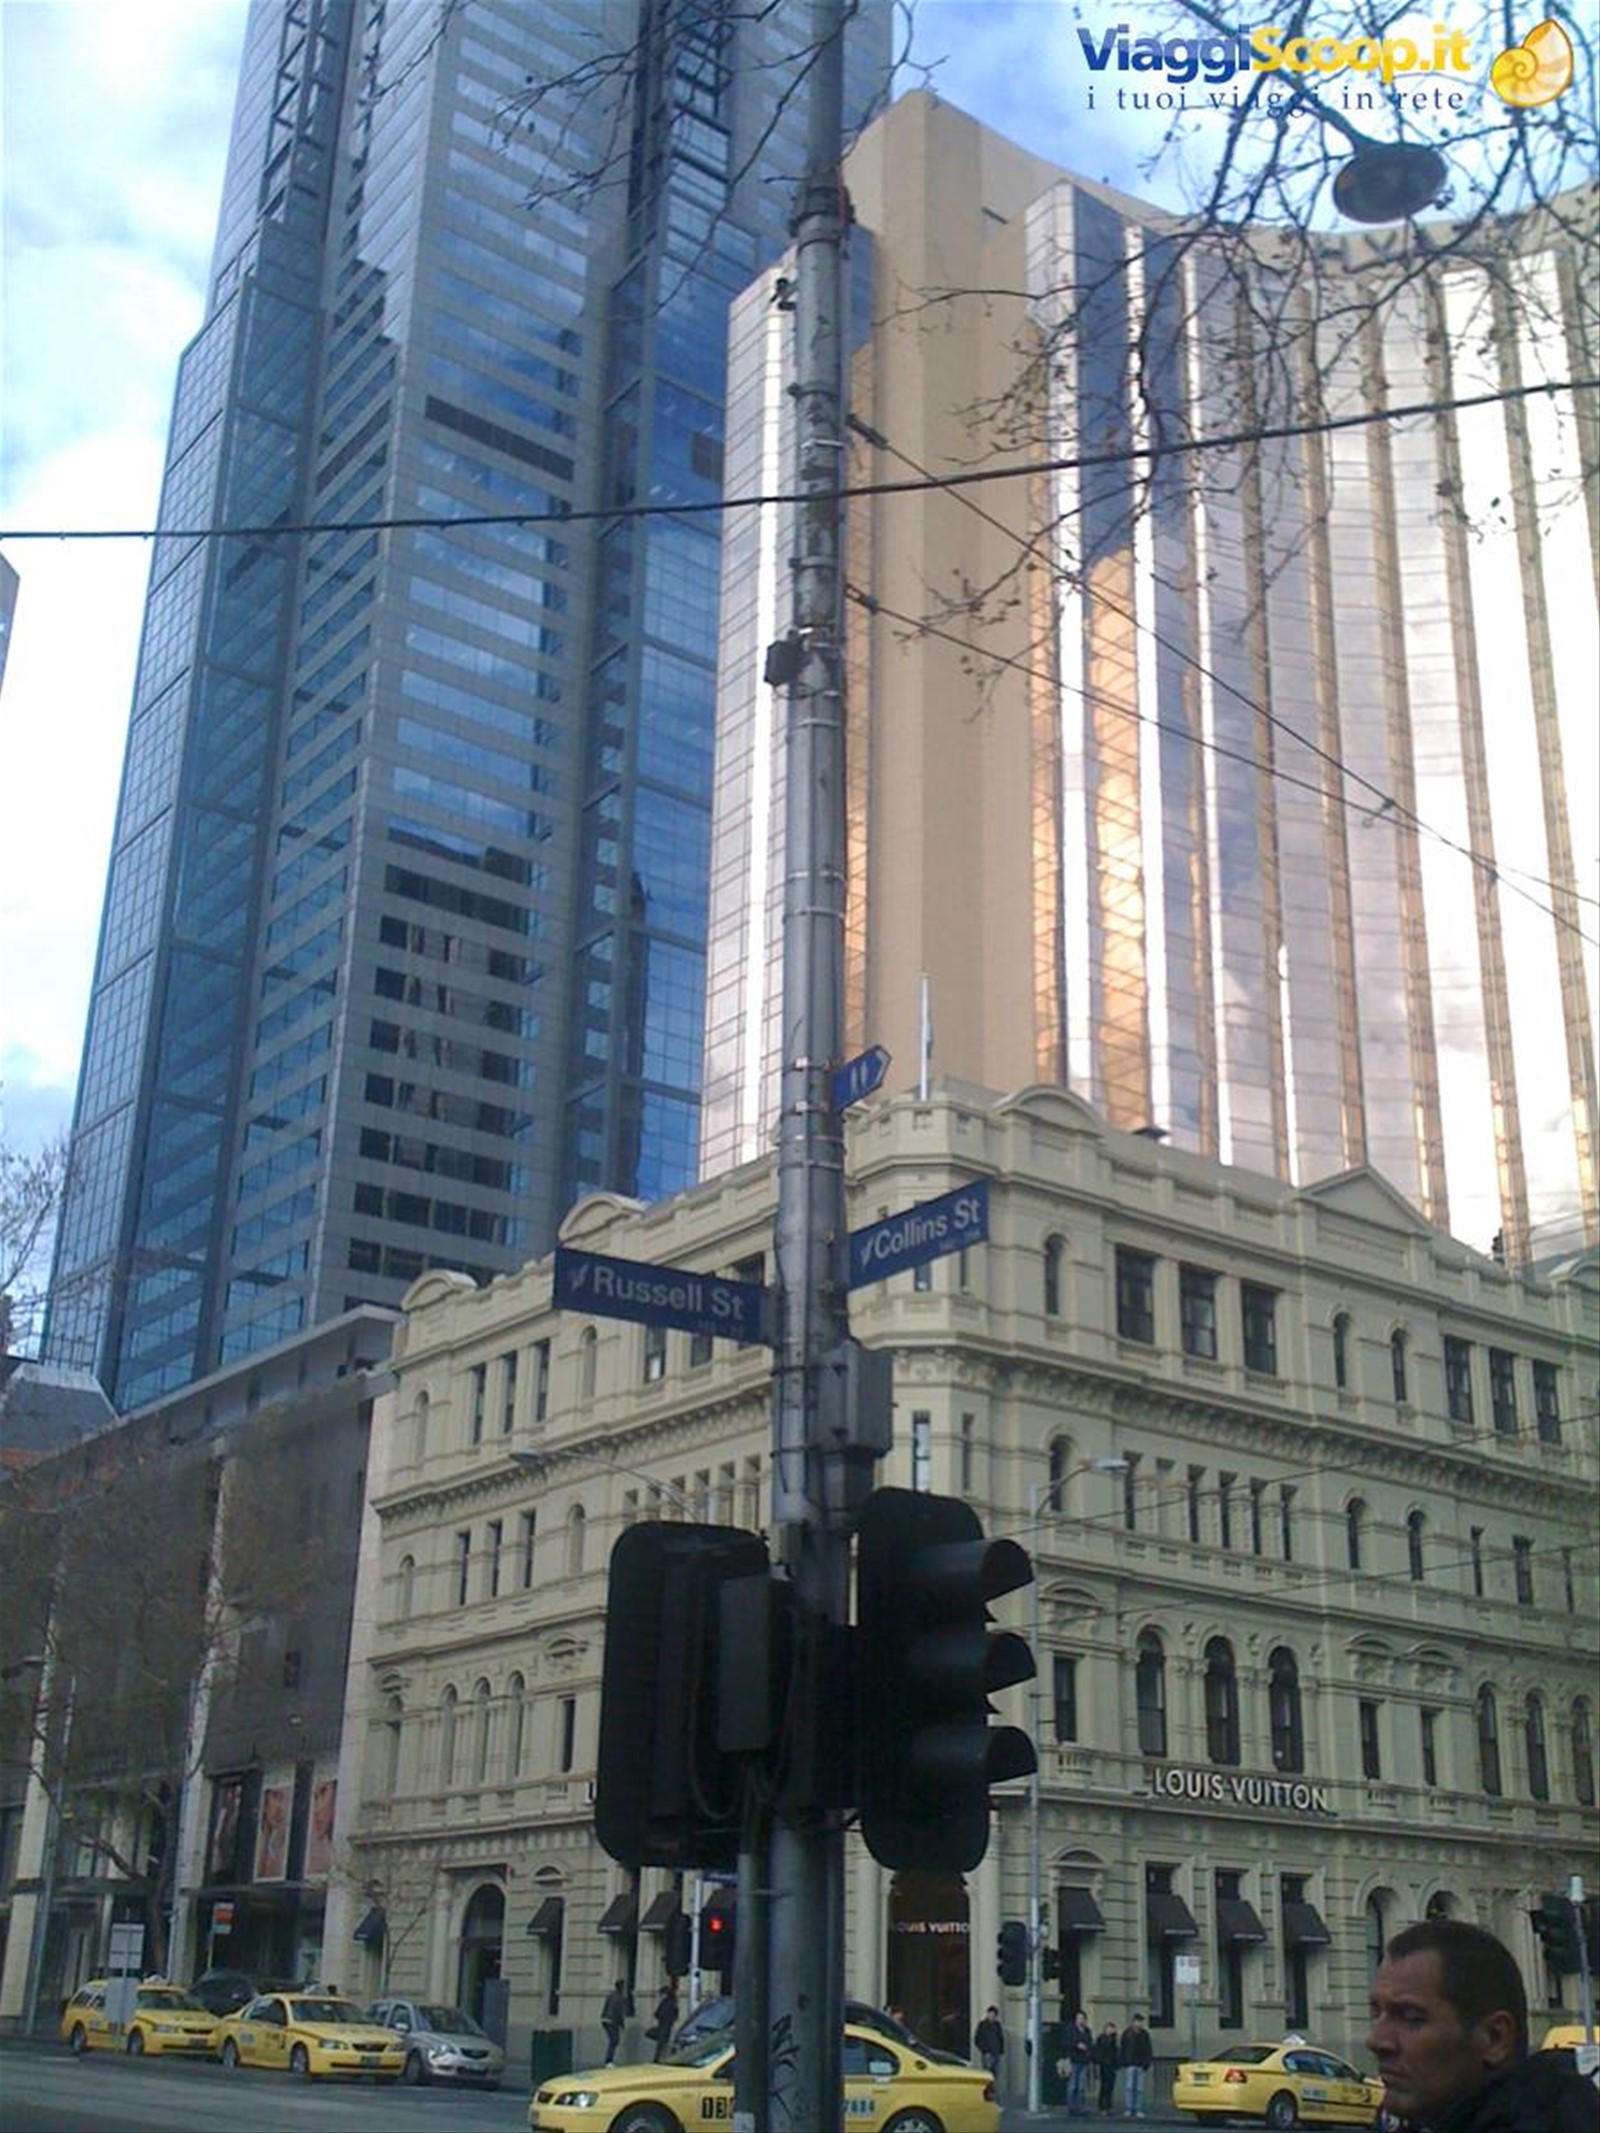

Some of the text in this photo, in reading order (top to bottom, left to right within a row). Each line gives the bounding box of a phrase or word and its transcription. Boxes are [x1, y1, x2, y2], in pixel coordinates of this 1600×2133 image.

[873, 1216, 948, 1261] Collins
[953, 1197, 981, 1231] St
[593, 1265, 745, 1322] Russell St
[1155, 1767, 1329, 1810] LOUIS VUITTON
